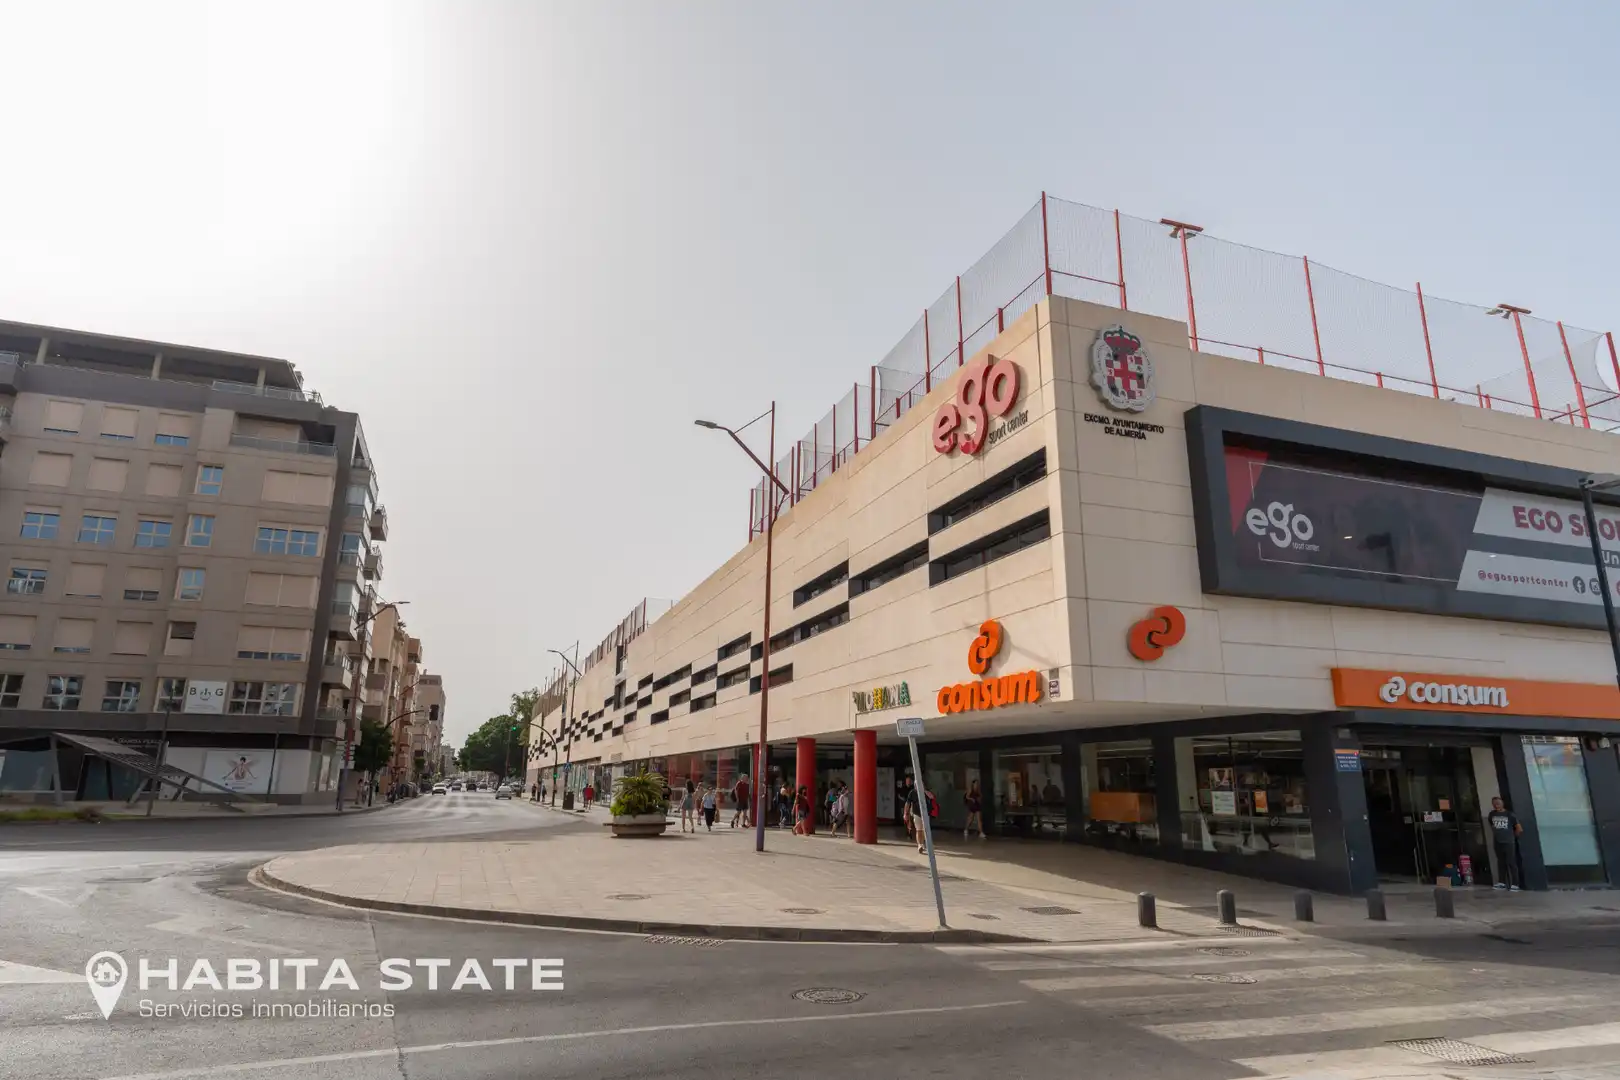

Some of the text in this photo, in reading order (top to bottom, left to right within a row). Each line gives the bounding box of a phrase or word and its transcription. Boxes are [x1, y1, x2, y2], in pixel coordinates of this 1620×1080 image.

[932, 355, 1020, 454] ego
[988, 409, 1029, 444] sport center
[1083, 413, 1165, 434] EXCMO. AYUNTAMIENTO
[1104, 426, 1115, 435] DE
[1246, 501, 1313, 548] ego
[1513, 505, 1563, 534] EGO
[1478, 570, 1569, 588] @egosportcenter
[937, 670, 1041, 714] consum
[1409, 681, 1509, 708] consum
